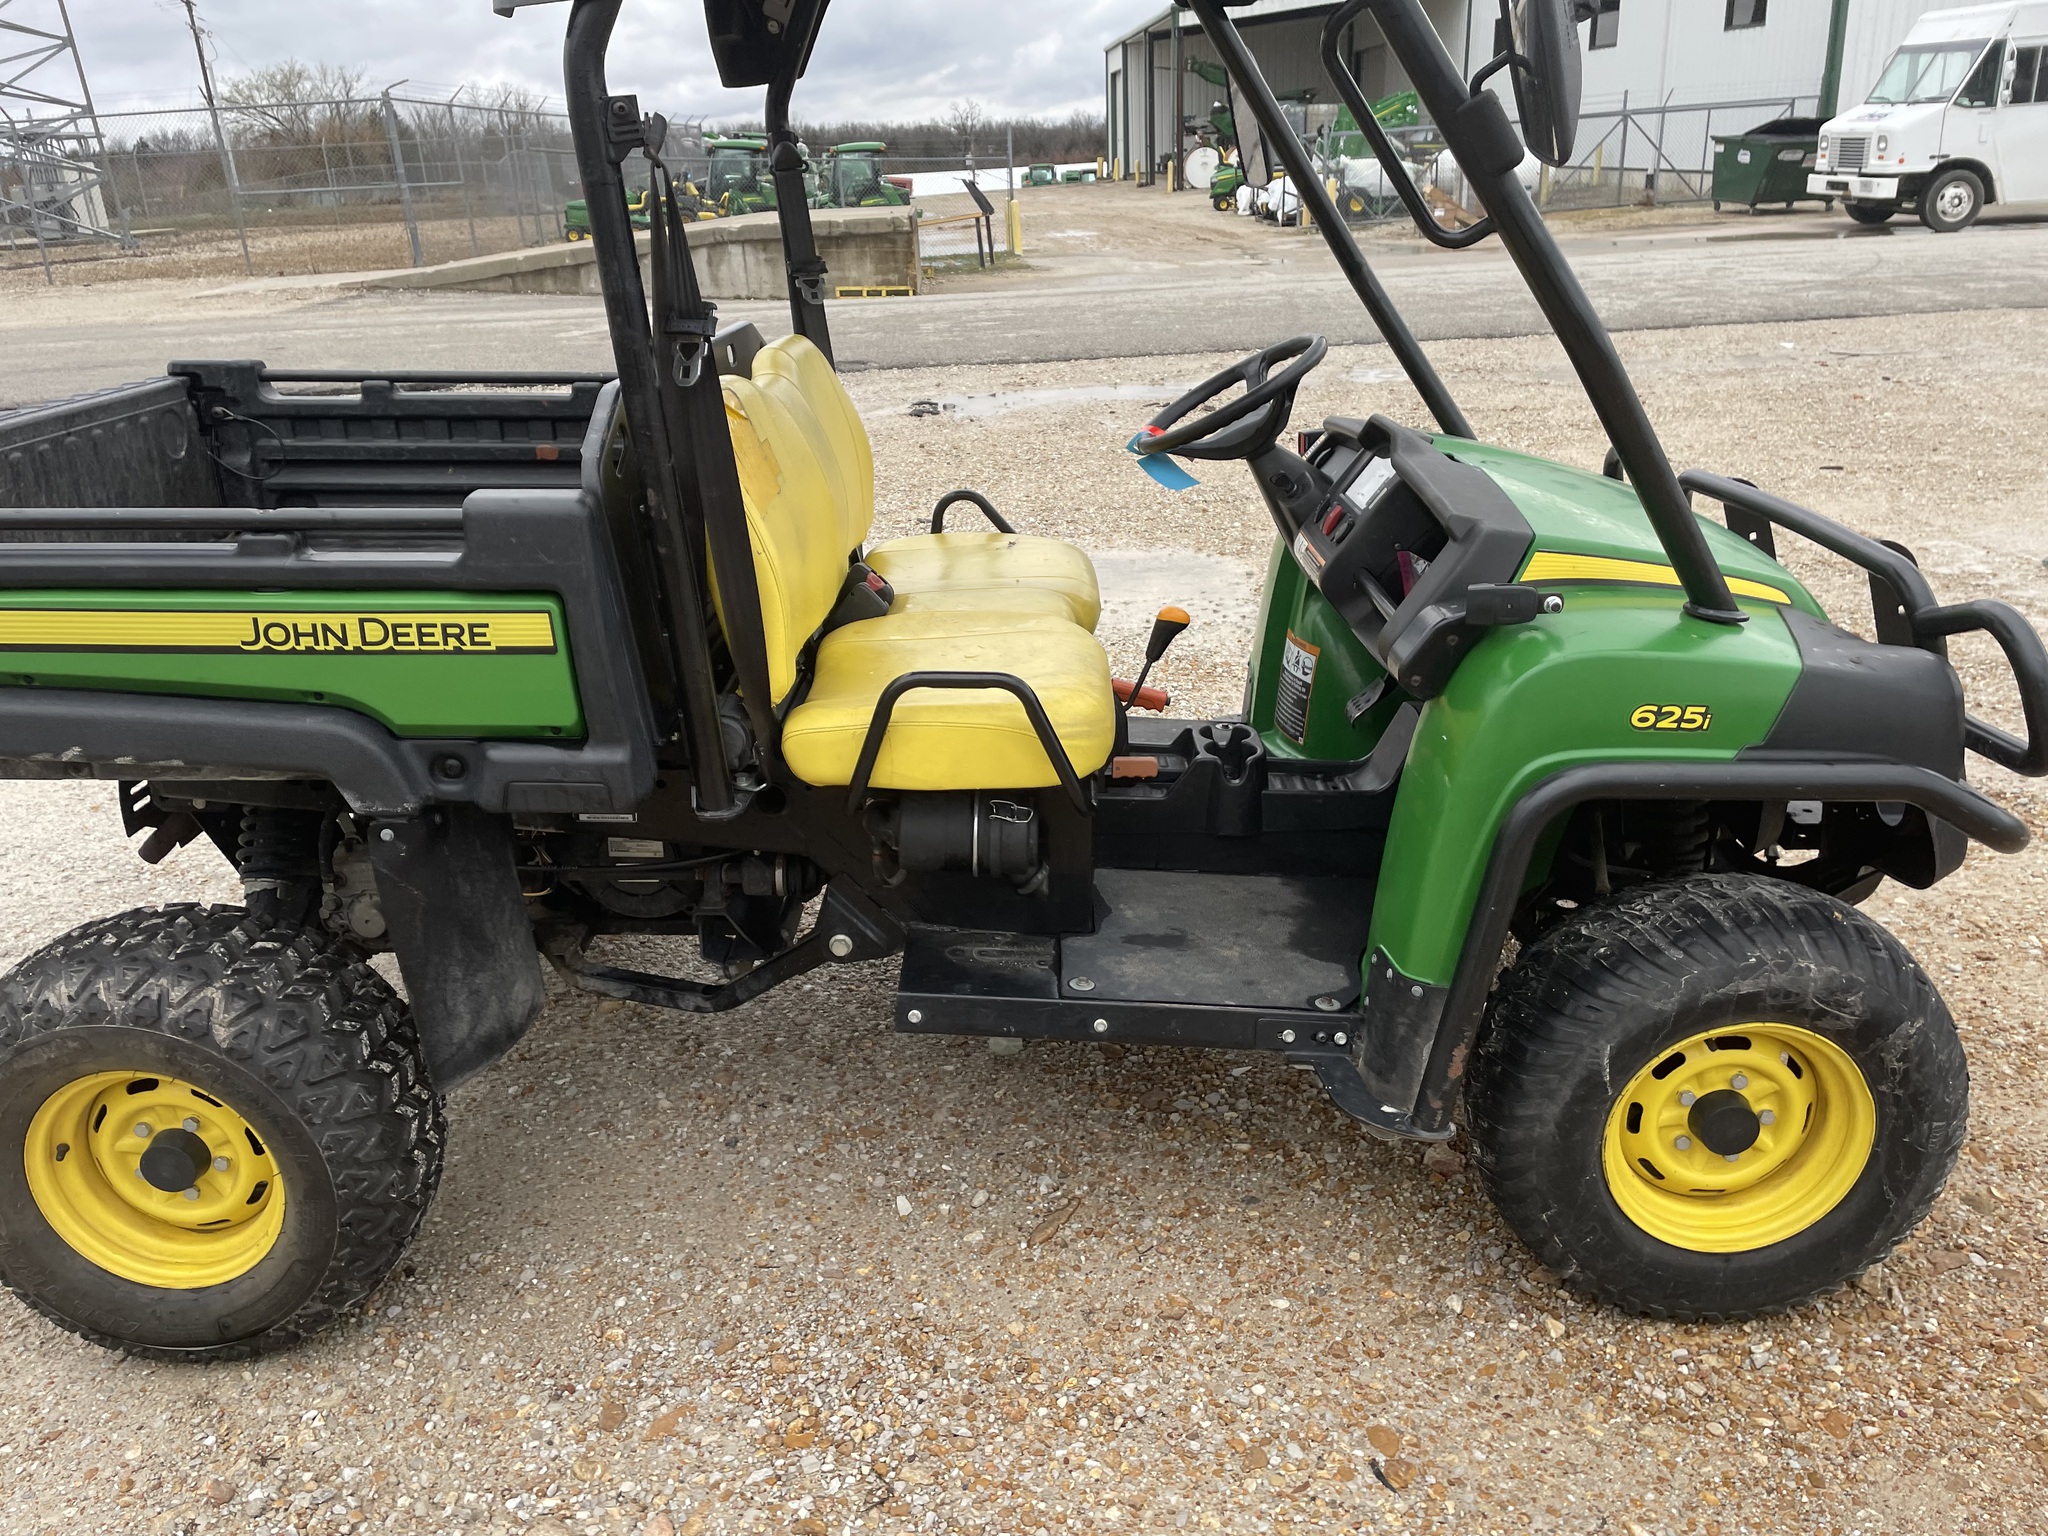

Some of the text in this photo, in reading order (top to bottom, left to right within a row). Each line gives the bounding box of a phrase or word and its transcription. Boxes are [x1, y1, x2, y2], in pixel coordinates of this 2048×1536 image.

[240, 616, 492, 647] JOHN DEERE
[1630, 704, 1712, 730] 625i
